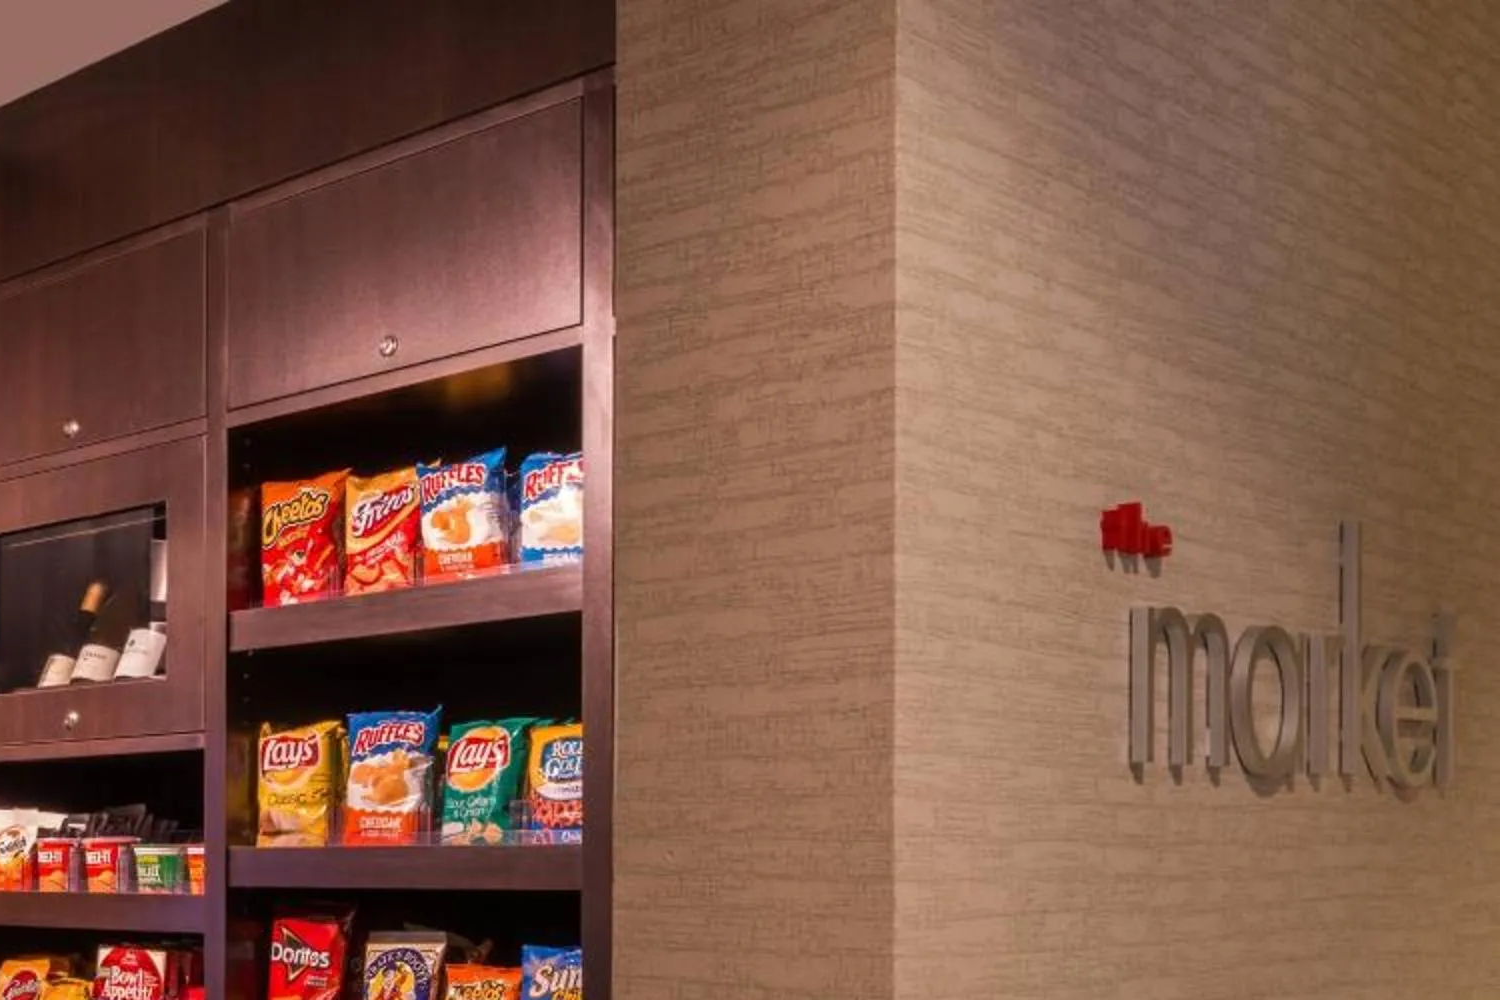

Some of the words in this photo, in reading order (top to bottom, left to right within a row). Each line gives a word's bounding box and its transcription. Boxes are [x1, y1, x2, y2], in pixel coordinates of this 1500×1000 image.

[262, 490, 329, 547] Cheetos
[352, 487, 415, 537] Fritos
[355, 723, 425, 753] RUFFLES
[271, 941, 331, 968] Doritos
[111, 965, 143, 986] Bowl
[529, 964, 582, 998] Sun
